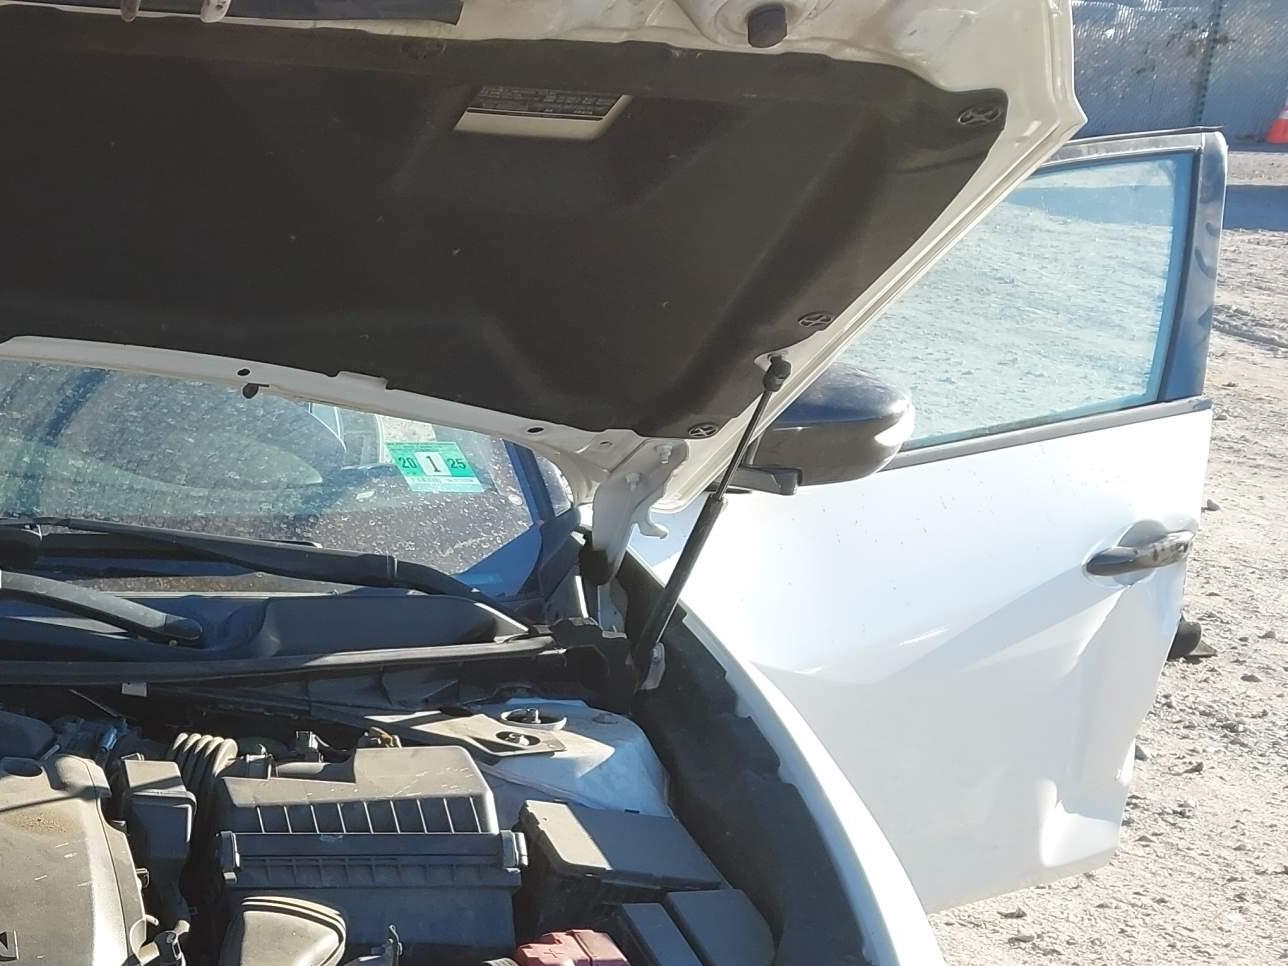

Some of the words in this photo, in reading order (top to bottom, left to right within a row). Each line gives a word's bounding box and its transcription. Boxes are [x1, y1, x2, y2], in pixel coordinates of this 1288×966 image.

[399, 457, 418, 469] 20
[426, 455, 442, 473] 1
[447, 457, 467, 469] 25
